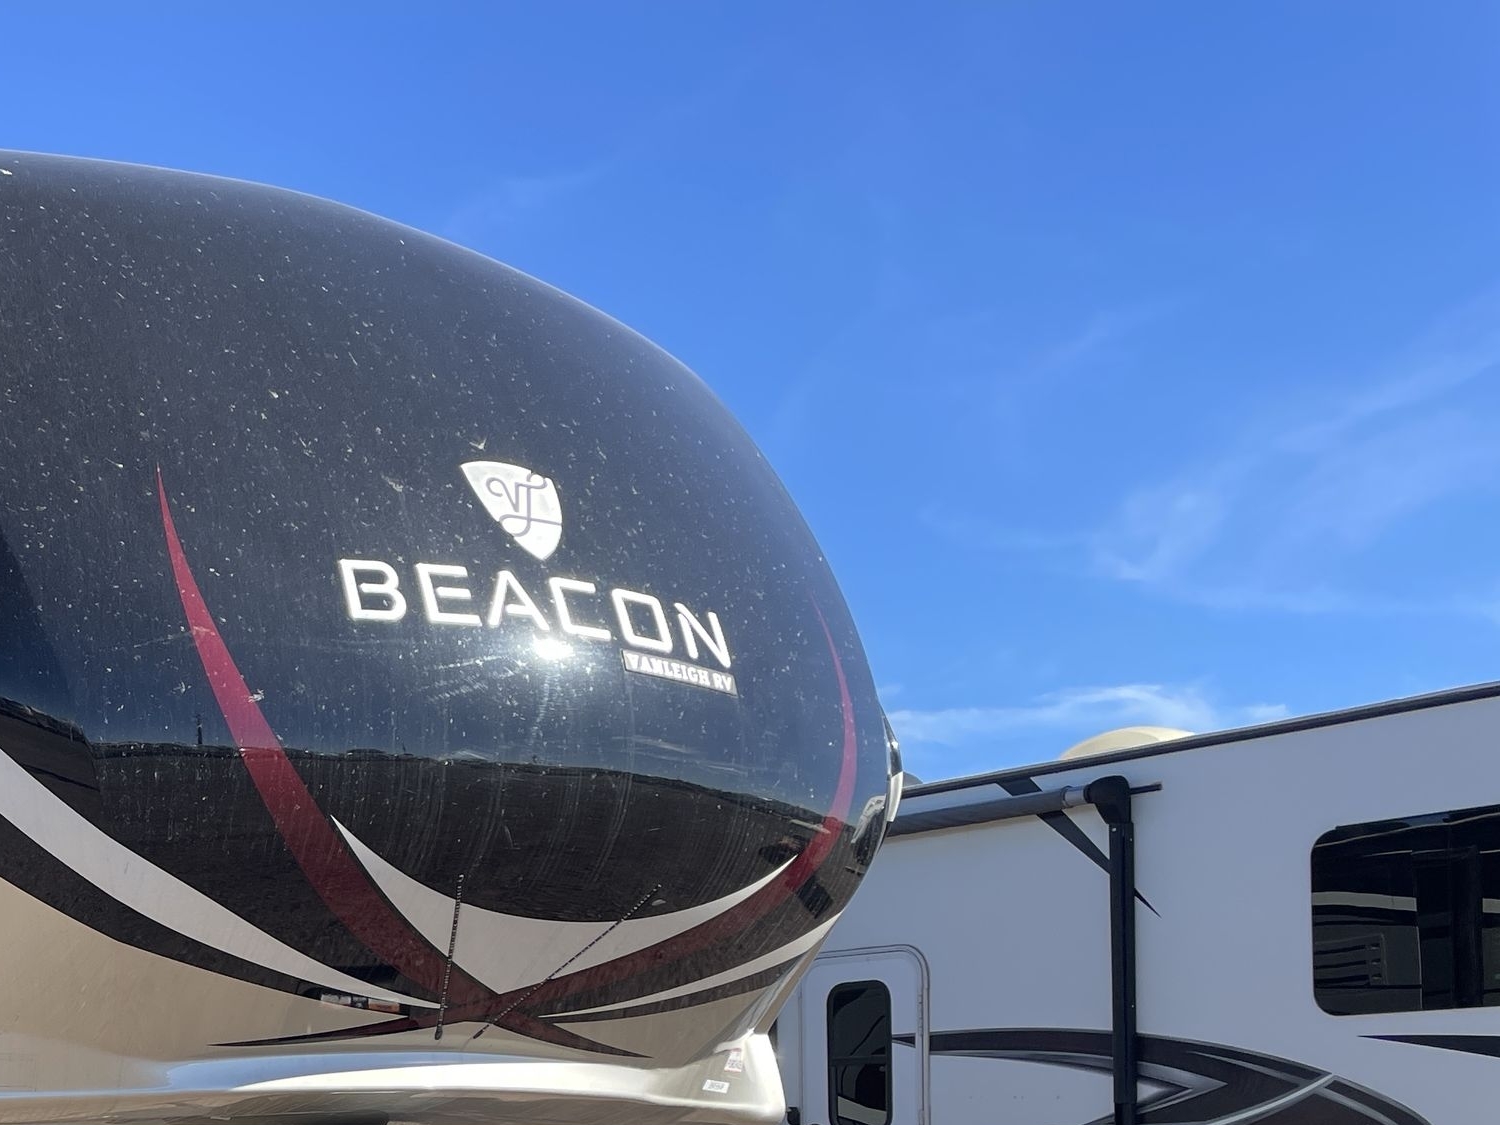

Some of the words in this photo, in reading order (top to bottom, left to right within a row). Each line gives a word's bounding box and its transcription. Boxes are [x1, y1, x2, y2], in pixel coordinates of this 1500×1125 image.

[339, 558, 732, 668] BEACON
[625, 653, 711, 687] VANLEIGH
[712, 672, 732, 692] RV
